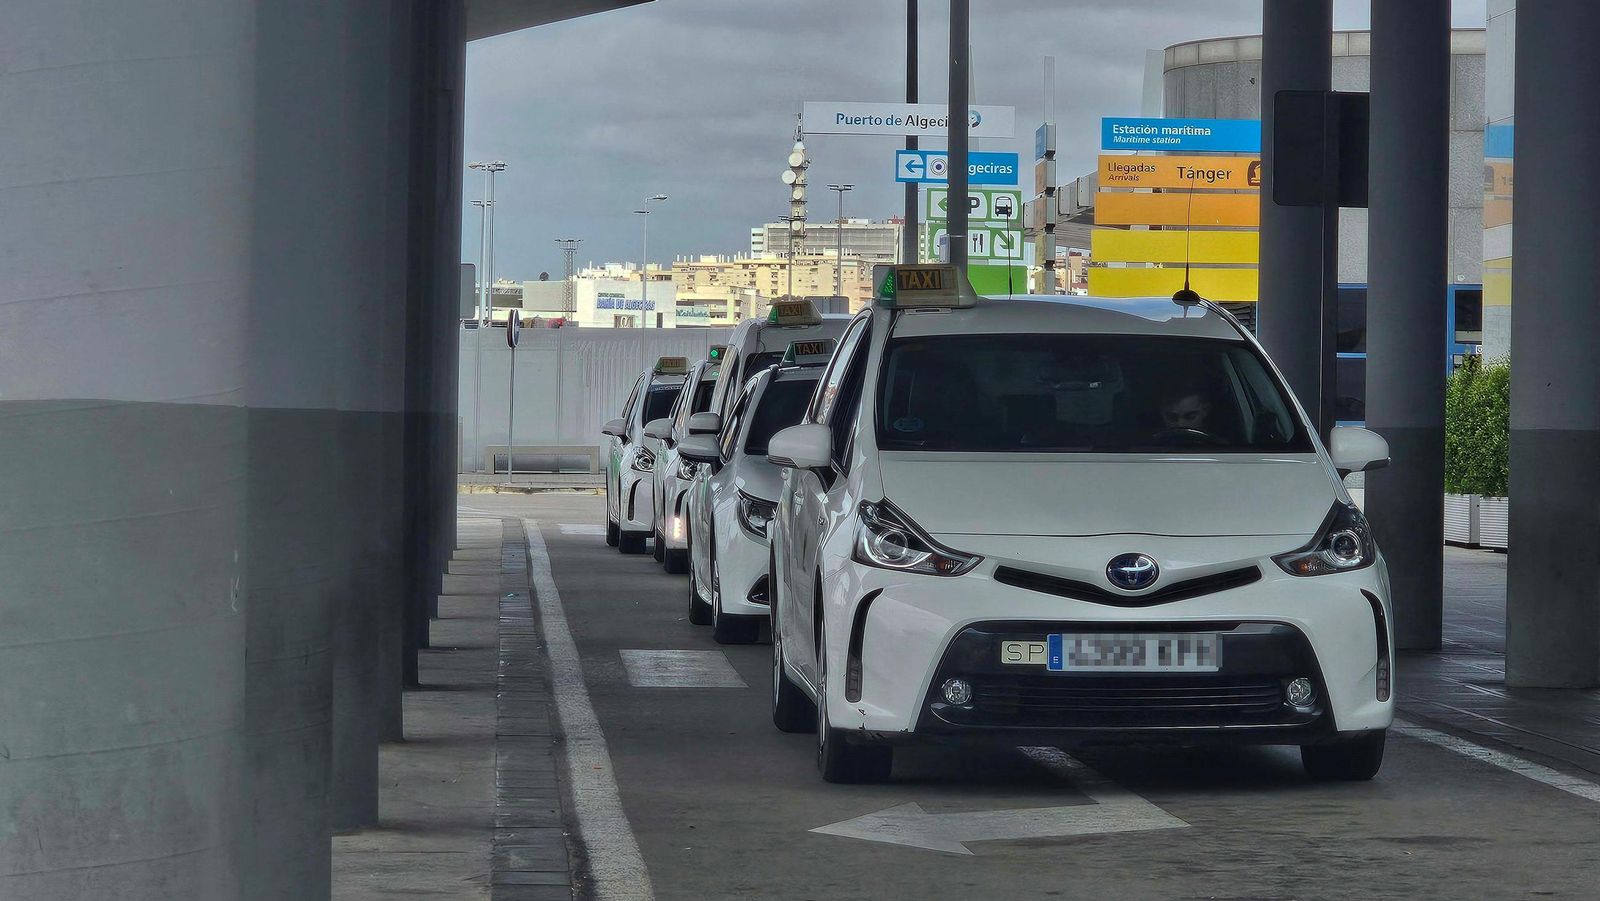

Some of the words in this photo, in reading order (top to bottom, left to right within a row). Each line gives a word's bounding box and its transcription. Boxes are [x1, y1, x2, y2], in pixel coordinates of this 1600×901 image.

[836, 112, 882, 126] Puerto
[885, 113, 902, 126] de
[904, 115, 969, 129] Algeci
[1112, 124, 1158, 135] Estación
[1161, 125, 1211, 136] marítima
[1113, 136, 1150, 144] Maritime
[968, 162, 1013, 175] geciras
[1108, 162, 1156, 175] Llegadas
[1176, 166, 1232, 183] Tánger
[1108, 174, 1139, 182] Arrivals
[899, 270, 941, 289] TAXI
[780, 304, 803, 316] TAXI
[796, 342, 824, 354] TAXI
[1006, 644, 1045, 661] SP
[1053, 655, 1059, 664] E
